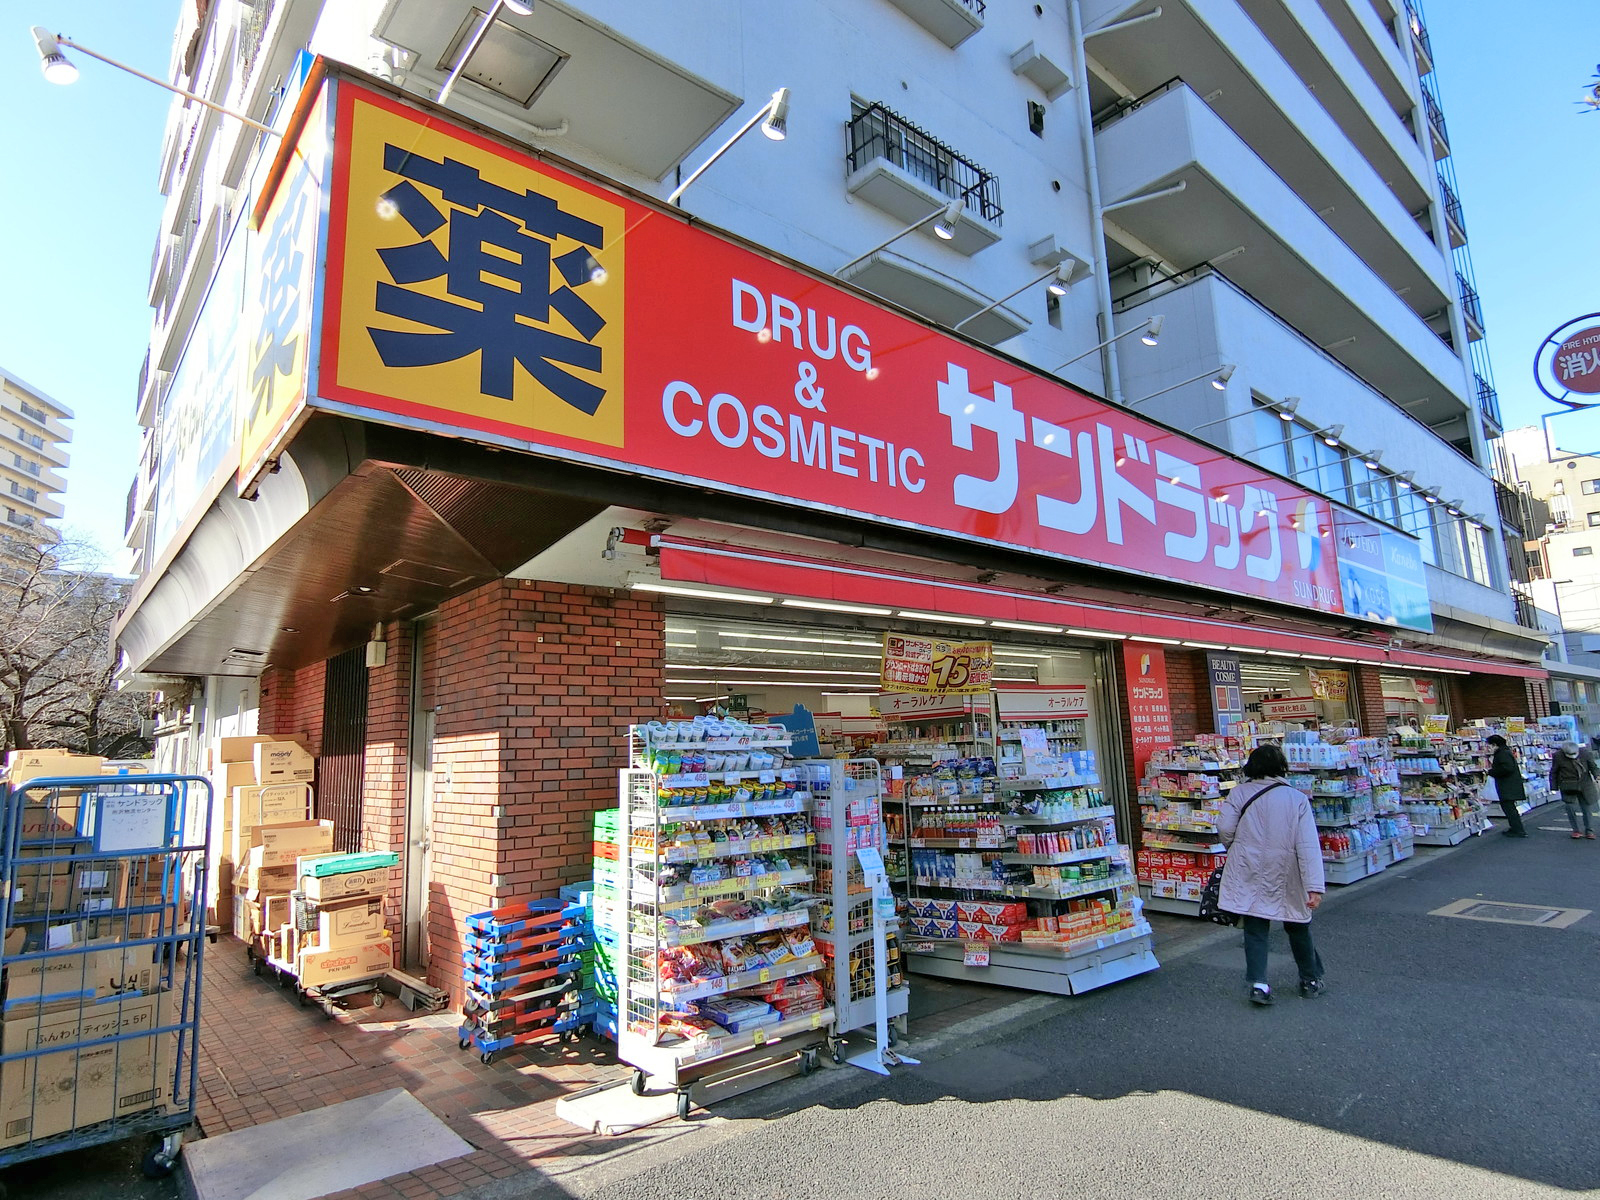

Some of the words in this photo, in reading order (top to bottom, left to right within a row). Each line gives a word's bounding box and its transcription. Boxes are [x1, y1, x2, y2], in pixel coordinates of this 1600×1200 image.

[366, 142, 607, 417] 薬
[732, 277, 872, 373] DRUG
[1562, 339, 1581, 351] FIRE
[794, 361, 827, 413] &
[661, 380, 926, 493] COSMETIC
[937, 361, 1282, 582] サンドラッグ
[1293, 580, 1337, 605] SUNDRUG
[932, 655, 970, 688] 15
[1212, 660, 1236, 671] BEAUTY
[1215, 671, 1237, 683] COSME
[1133, 686, 1163, 699] サンドラッグ
[893, 694, 946, 709] オーラルケア
[1048, 696, 1085, 708] オーラルケア
[1271, 703, 1307, 713] 基礎化粧品
[737, 737, 750, 745] 478
[694, 773, 707, 782] 458
[727, 803, 740, 812] 458
[783, 800, 795, 809] 458
[711, 979, 723, 989] 148
[38, 1020, 129, 1045] ふんわりティッシュ
[133, 1013, 148, 1023] 5P
